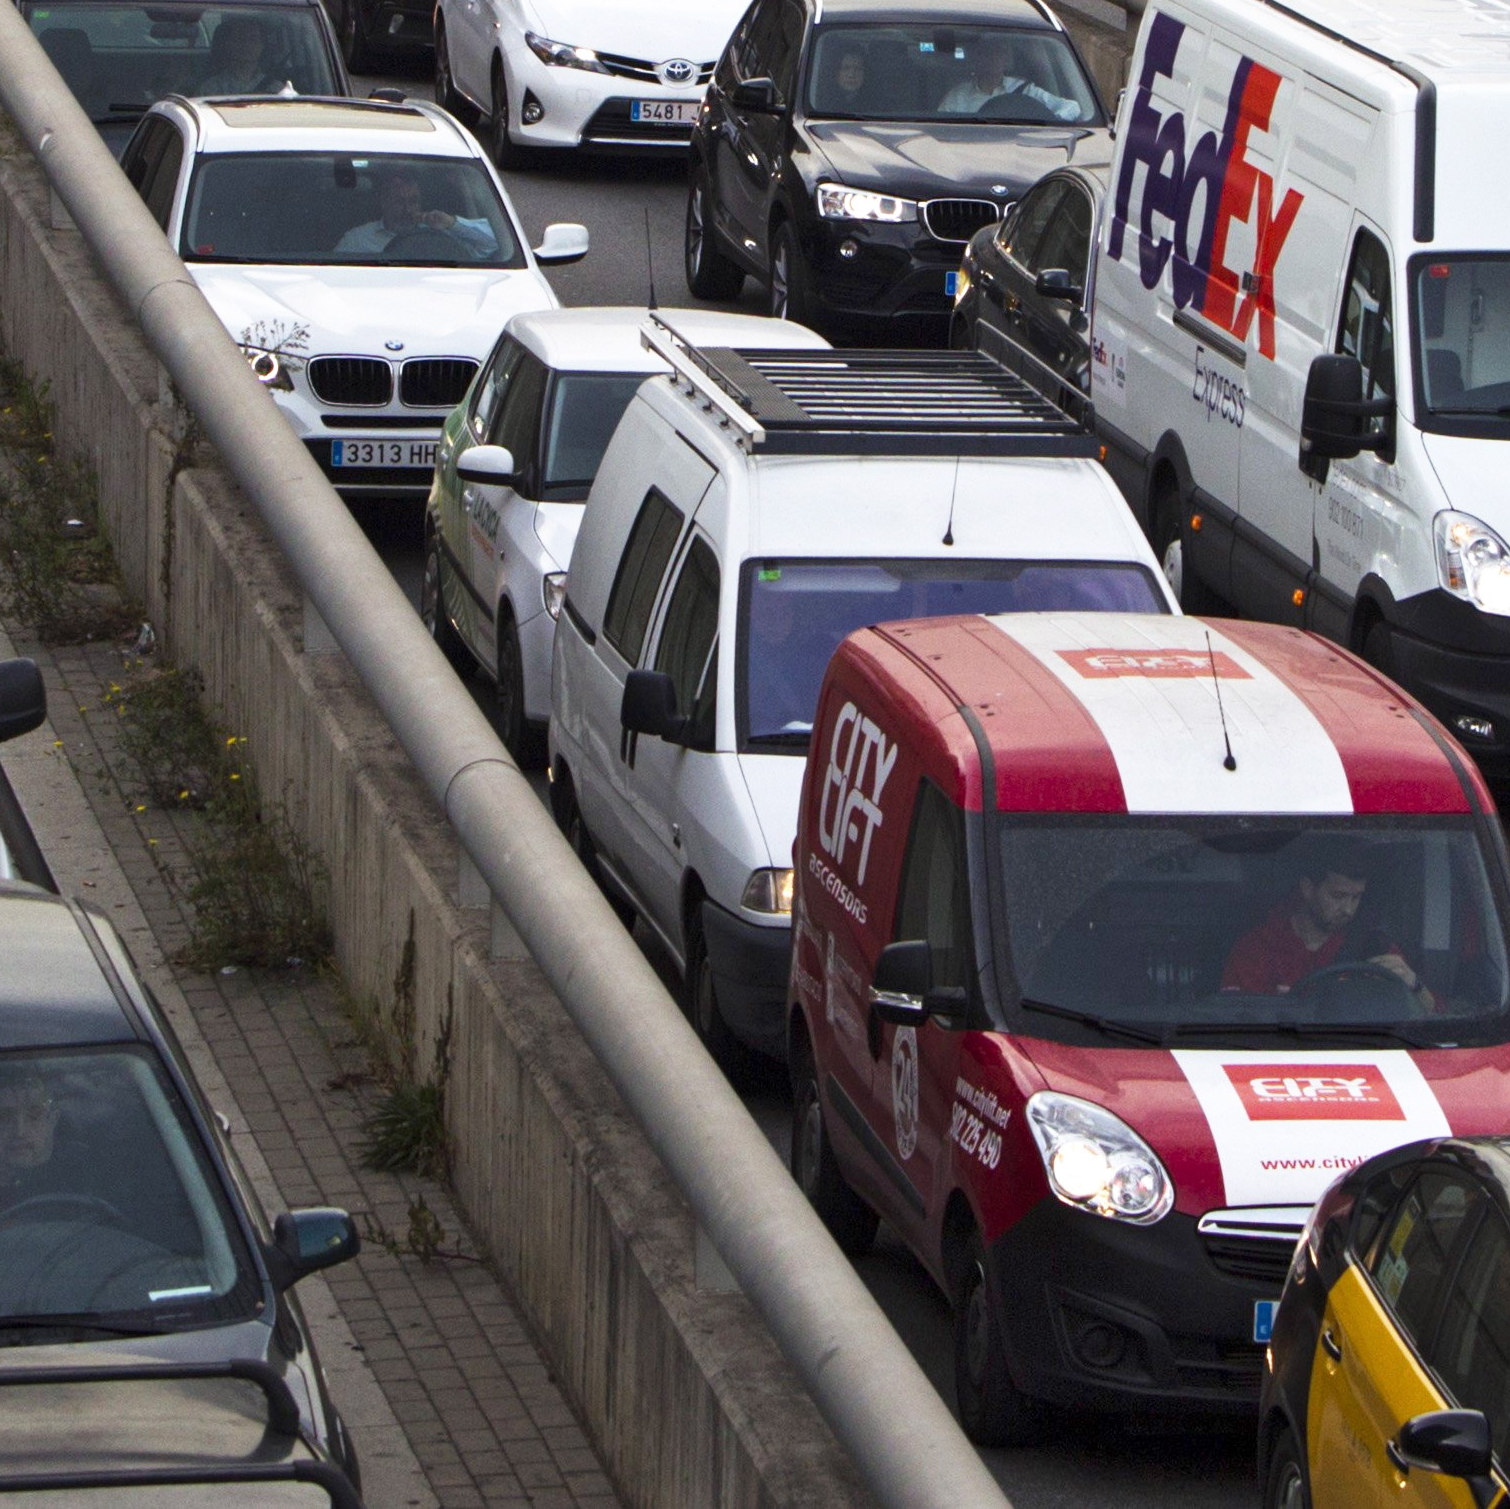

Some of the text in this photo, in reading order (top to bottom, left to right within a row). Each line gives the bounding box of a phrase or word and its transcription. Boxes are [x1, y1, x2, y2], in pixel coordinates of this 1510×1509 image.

[642, 103, 682, 119] 5481
[1108, 11, 1304, 361] FedEx
[1192, 345, 1246, 429] Express
[346, 444, 438, 465] 3313 HH
[829, 701, 899, 806] CITY
[819, 762, 883, 888] LIFT
[960, 1114, 984, 1156] 225
[978, 1128, 1003, 1170] 490
